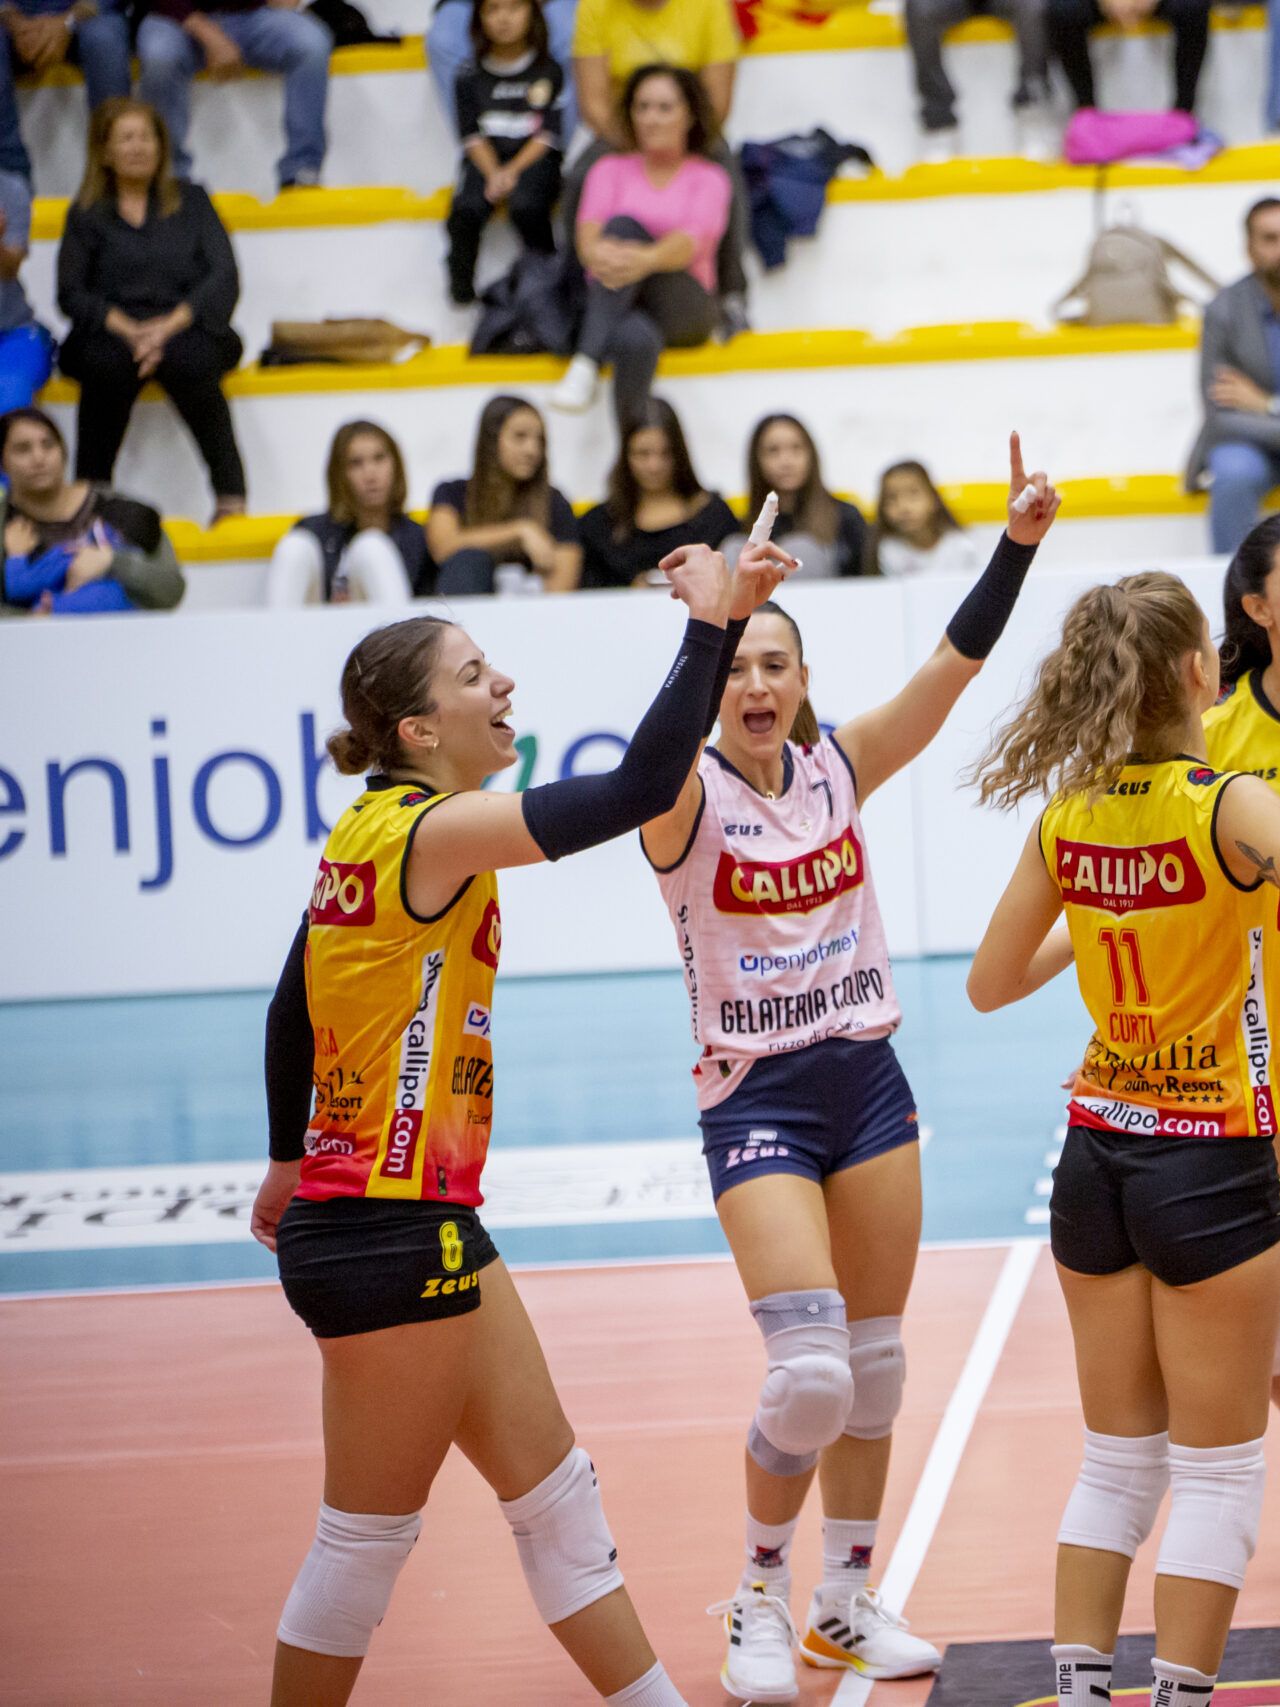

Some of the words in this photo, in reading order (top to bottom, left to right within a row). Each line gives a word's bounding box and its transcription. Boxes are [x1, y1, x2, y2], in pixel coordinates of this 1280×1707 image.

[811, 778, 834, 818] 7
[724, 824, 763, 836] eus
[731, 839, 857, 904] CALLIPO
[1098, 928, 1150, 1007] 11
[720, 988, 828, 1035] GELATERIA
[1109, 1012, 1157, 1045] CURTI
[726, 1146, 789, 1168] Zeus
[439, 1221, 464, 1272] 8
[420, 1271, 479, 1298] Zeus
[1059, 1663, 1073, 1695] nine
